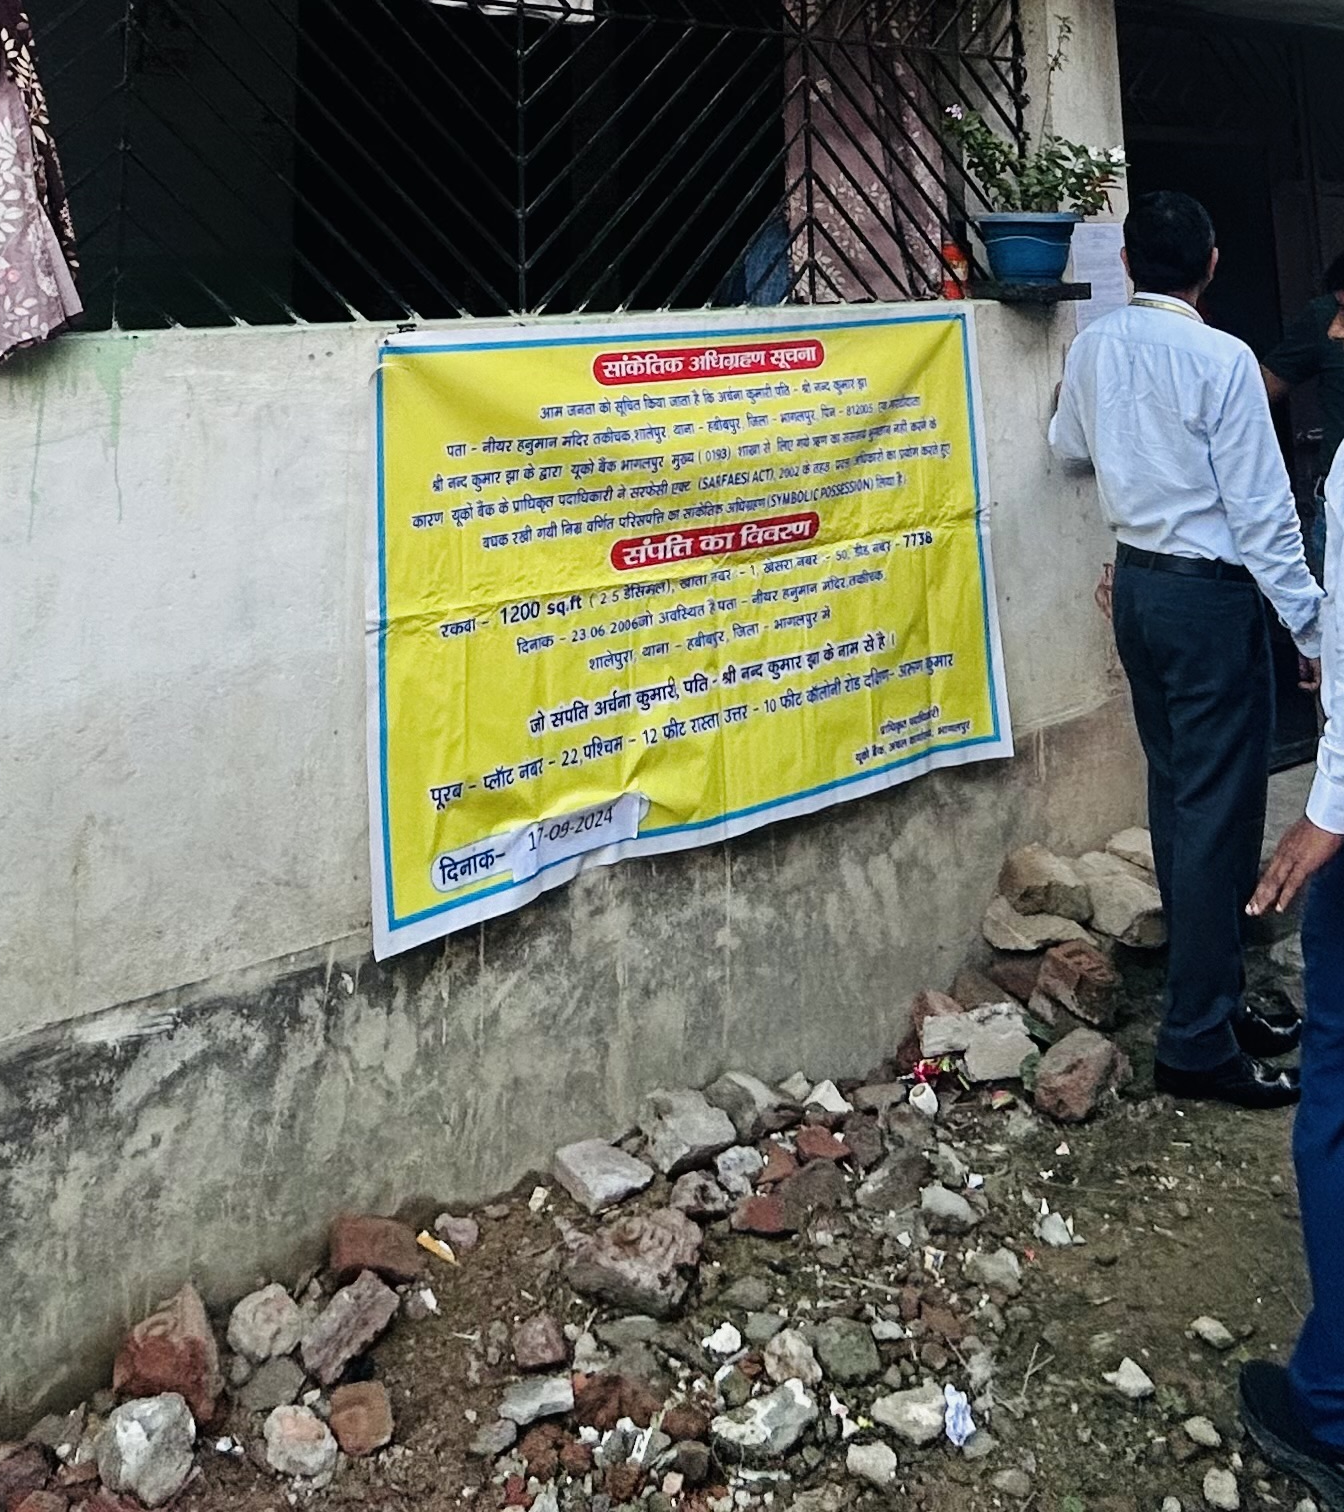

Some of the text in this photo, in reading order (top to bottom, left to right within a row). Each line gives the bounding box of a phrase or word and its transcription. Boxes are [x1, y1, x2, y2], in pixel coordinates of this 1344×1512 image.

[602, 346, 817, 378] सांकेतिक अधिग्रहण सूचना
[540, 405, 562, 420] आम
[567, 403, 595, 417] जनता
[599, 397, 611, 414] को
[615, 394, 640, 417] सूचित
[643, 394, 666, 410] किया
[669, 394, 691, 408] जाता
[694, 389, 700, 405] है
[703, 389, 714, 403] कि
[745, 383, 773, 405] कुमारी
[774, 381, 790, 397] पति
[833, 378, 855, 395] कुमार
[446, 444, 466, 457] पता
[482, 436, 512, 454] नीयर
[516, 436, 558, 455] हनुमान
[747, 412, 769, 428] जिला
[432, 472, 444, 492] श्री
[448, 475, 468, 490] नन्द
[471, 471, 501, 493] कुमार
[506, 469, 519, 486] झा
[523, 463, 535, 480] के
[539, 466, 562, 482] द्वारा
[570, 458, 594, 480] यूको
[621, 455, 664, 474] भागलपुर
[671, 451, 694, 471] मुख्य
[738, 443, 760, 458] शाखा
[763, 438, 771, 454] से
[777, 436, 794, 452] लिए
[412, 511, 444, 528] कारण
[451, 503, 473, 527] यूको
[498, 496, 509, 515] के
[513, 492, 554, 514] प्राधिकृत
[558, 485, 613, 505] पदाधिकारी
[617, 483, 626, 500] ने
[630, 479, 668, 499] सरफेसी
[698, 472, 749, 490] (SARFAESI
[512, 525, 532, 545] रखी
[536, 521, 558, 540] गयी
[586, 513, 615, 533] वर्णित
[668, 509, 680, 521] का
[622, 519, 812, 566] संपत्ति का विवरण
[500, 600, 540, 625] 1200
[547, 594, 582, 616] sq.ft
[679, 575, 707, 589] खाता
[763, 557, 793, 574] खेसरा
[902, 531, 933, 548] 7738
[658, 603, 705, 625] अवस्थित
[752, 589, 778, 605] नीयर
[782, 583, 817, 603] हनुमान
[733, 623, 760, 639] जिला
[774, 611, 817, 630] भागलपुर
[822, 605, 831, 620] में
[530, 710, 545, 734] जो
[594, 690, 631, 716] अर्चना
[636, 676, 679, 710] कुमारी,
[683, 674, 708, 694] पति
[722, 665, 736, 685] श्री
[741, 663, 763, 681] नन्द
[767, 654, 802, 679] कुमार
[806, 651, 820, 670] झा
[824, 643, 834, 662] के
[838, 640, 859, 658] नाम
[863, 634, 874, 653] से
[430, 782, 463, 810] पूरब
[483, 766, 514, 790] प्लॉट
[642, 729, 658, 745] 12
[663, 717, 686, 740] फीट
[691, 712, 719, 734] रास्ता
[724, 704, 747, 723] उत्तर
[764, 699, 776, 713] 10
[780, 688, 802, 709] फीट
[807, 678, 841, 703] कॉलोनी
[844, 673, 861, 692] रोड
[926, 653, 953, 675] कुमार
[528, 805, 613, 852] 17-09-2024
